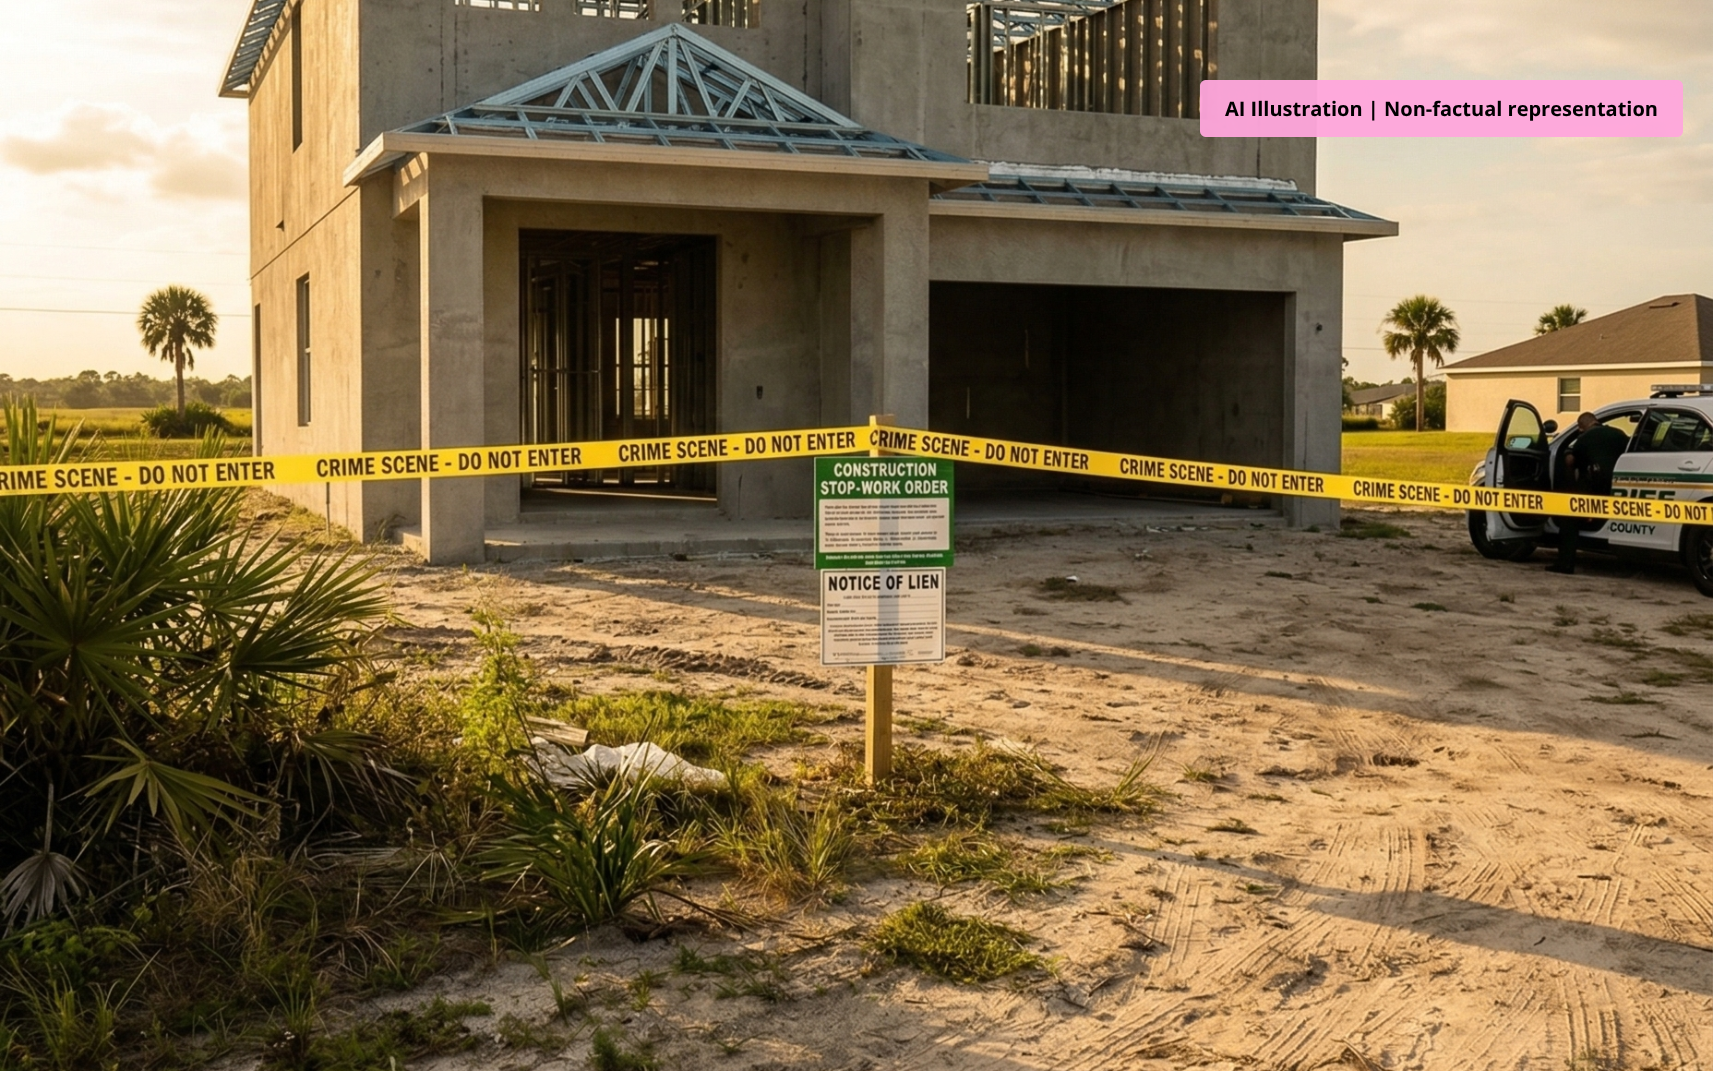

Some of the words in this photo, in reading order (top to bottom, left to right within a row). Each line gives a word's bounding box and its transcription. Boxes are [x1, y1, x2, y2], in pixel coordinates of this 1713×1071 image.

[619, 443, 671, 462] CRIME
[677, 441, 727, 458] SCENE
[745, 437, 766, 454] DO
[771, 435, 802, 453] NOT
[807, 432, 855, 451] ENTER
[870, 430, 917, 450] CRIME
[922, 436, 969, 456] SCENE
[985, 444, 1005, 461] DO
[1010, 445, 1039, 465] NOT
[1043, 448, 1088, 469] ENTER
[55, 467, 117, 488] SCENE
[139, 466, 165, 485] DO
[172, 464, 210, 484] NOT
[215, 461, 275, 482] ENTER
[316, 458, 376, 476] CRIME
[381, 455, 439, 474] SCENE
[458, 452, 482, 469] DO
[488, 451, 522, 469] NOT
[527, 448, 581, 468] ENTER
[834, 463, 936, 477] CONSTRUCTION
[1120, 458, 1164, 476] CRIME
[1170, 463, 1214, 482] SCENE
[1228, 469, 1247, 486] DO
[1251, 471, 1277, 489] NOT
[1282, 474, 1324, 492] ENTER
[820, 481, 901, 495] STOP-WORK
[905, 480, 948, 493] ORDER
[1353, 481, 1395, 498] CRIME
[1398, 484, 1440, 502] SCENE
[1453, 489, 1471, 505] DO
[1475, 489, 1500, 507] NOT
[1504, 491, 1543, 510] ENTER
[1570, 497, 1609, 514] CRIME
[1613, 500, 1652, 517] SCENE
[1665, 504, 1680, 519] DO
[1685, 505, 1707, 520] NOT
[1610, 522, 1655, 535] COUNTY
[828, 575, 881, 591] NOTICE
[886, 575, 903, 590] OF
[908, 574, 939, 590] LIEN
